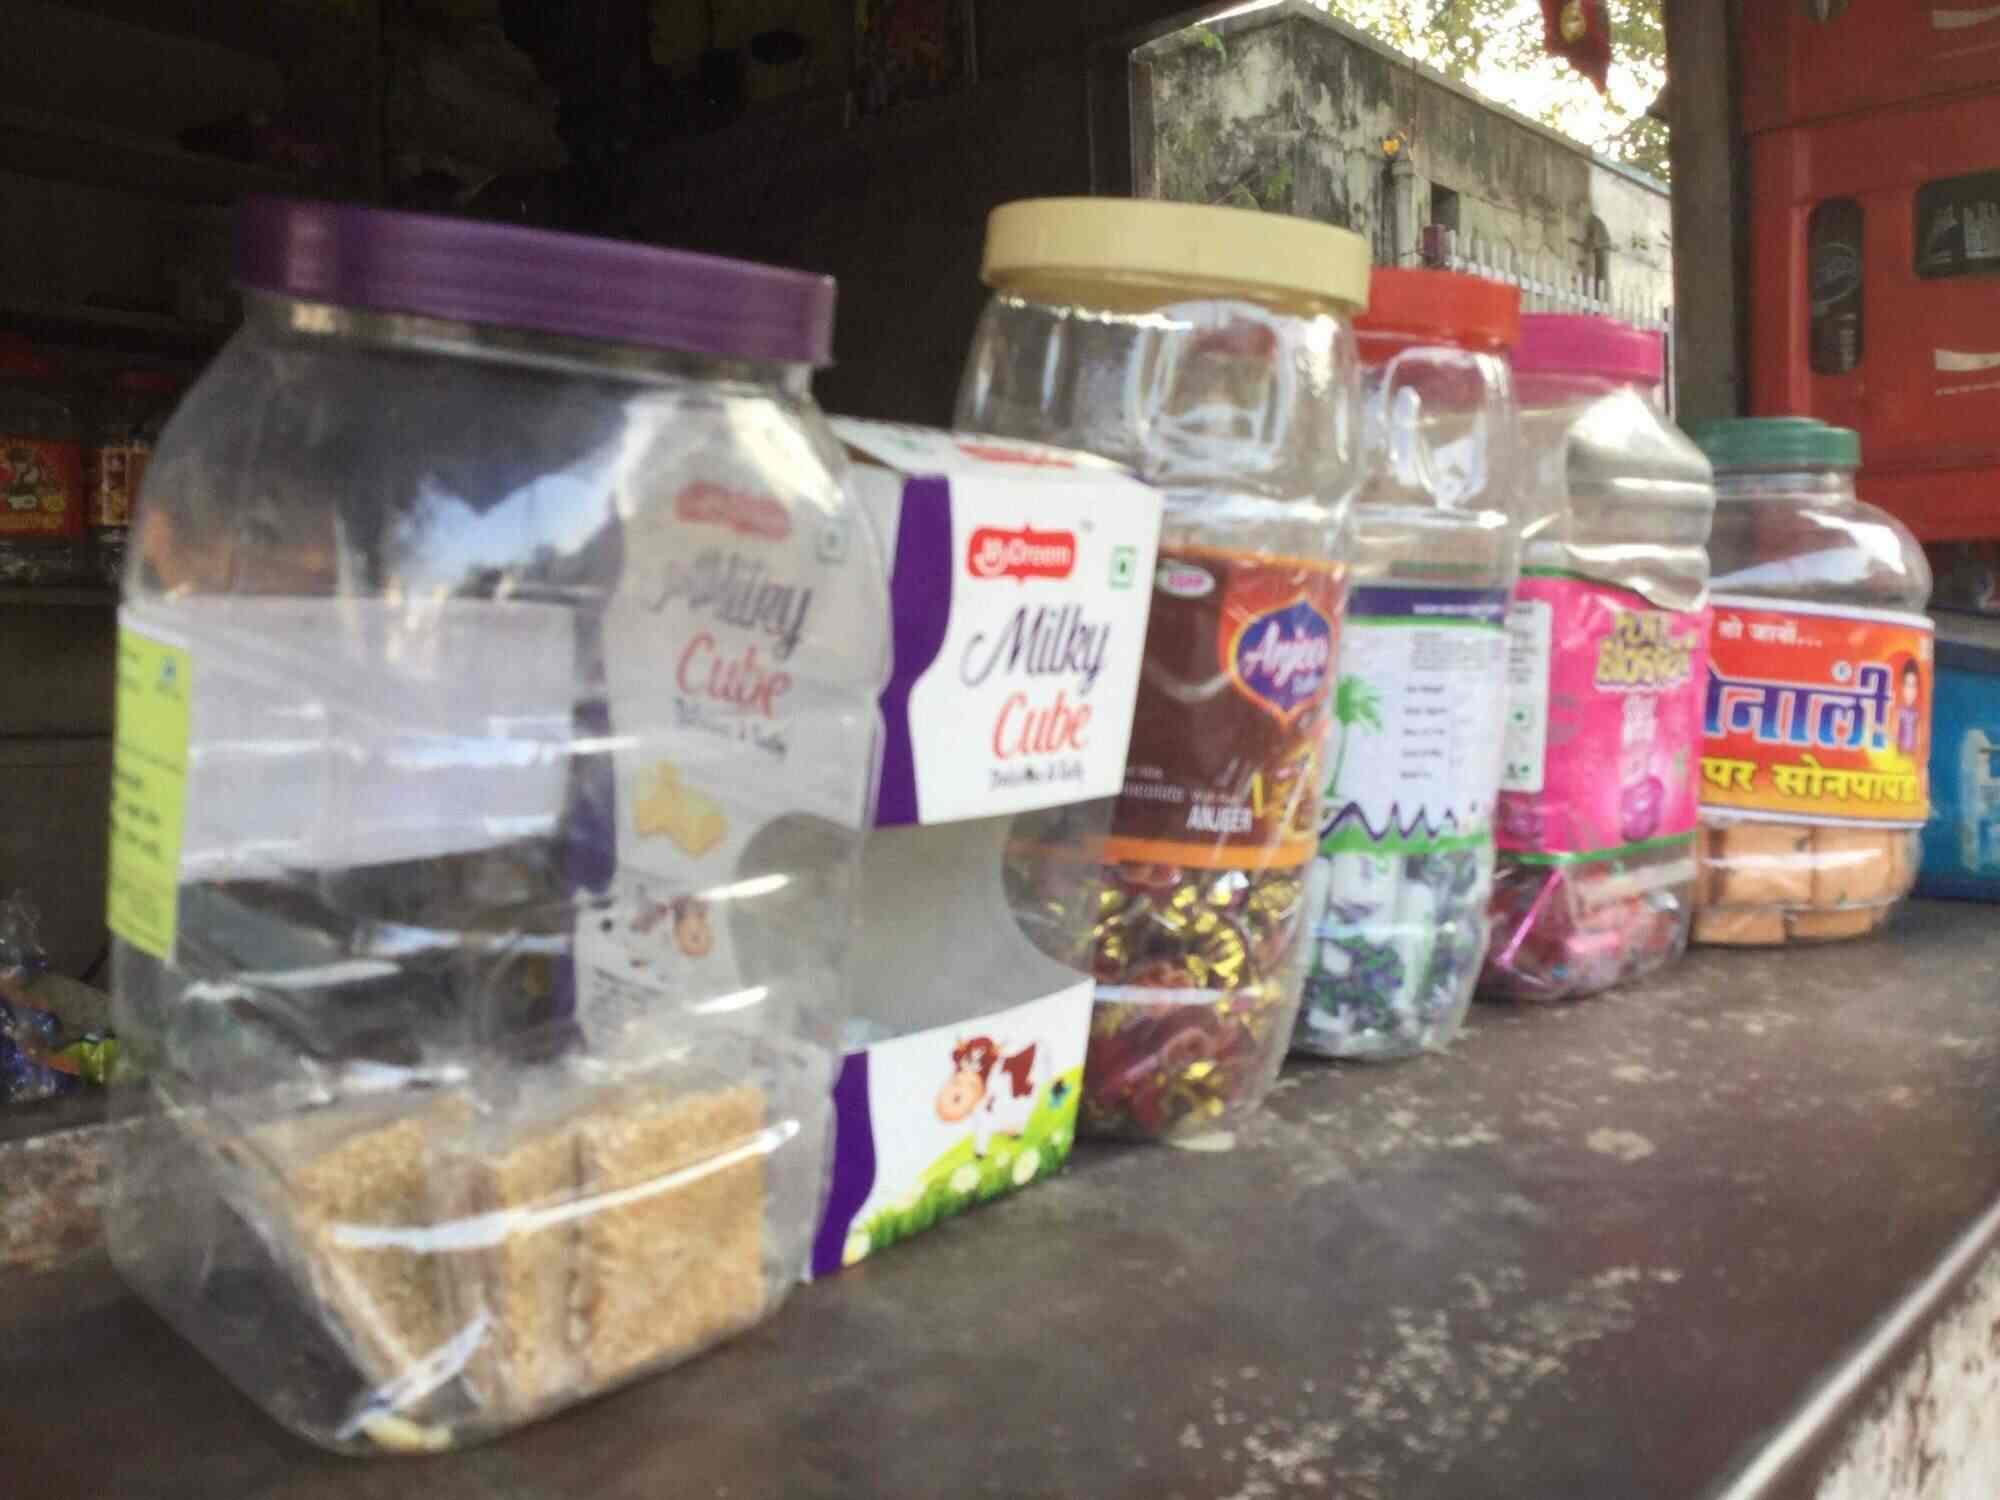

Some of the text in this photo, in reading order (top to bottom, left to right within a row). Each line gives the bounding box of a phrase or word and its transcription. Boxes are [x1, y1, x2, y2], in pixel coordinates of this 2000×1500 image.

[961, 603, 1110, 696] Milky
[992, 690, 1092, 760] Cube
[1185, 803, 1252, 832] ANJEER
